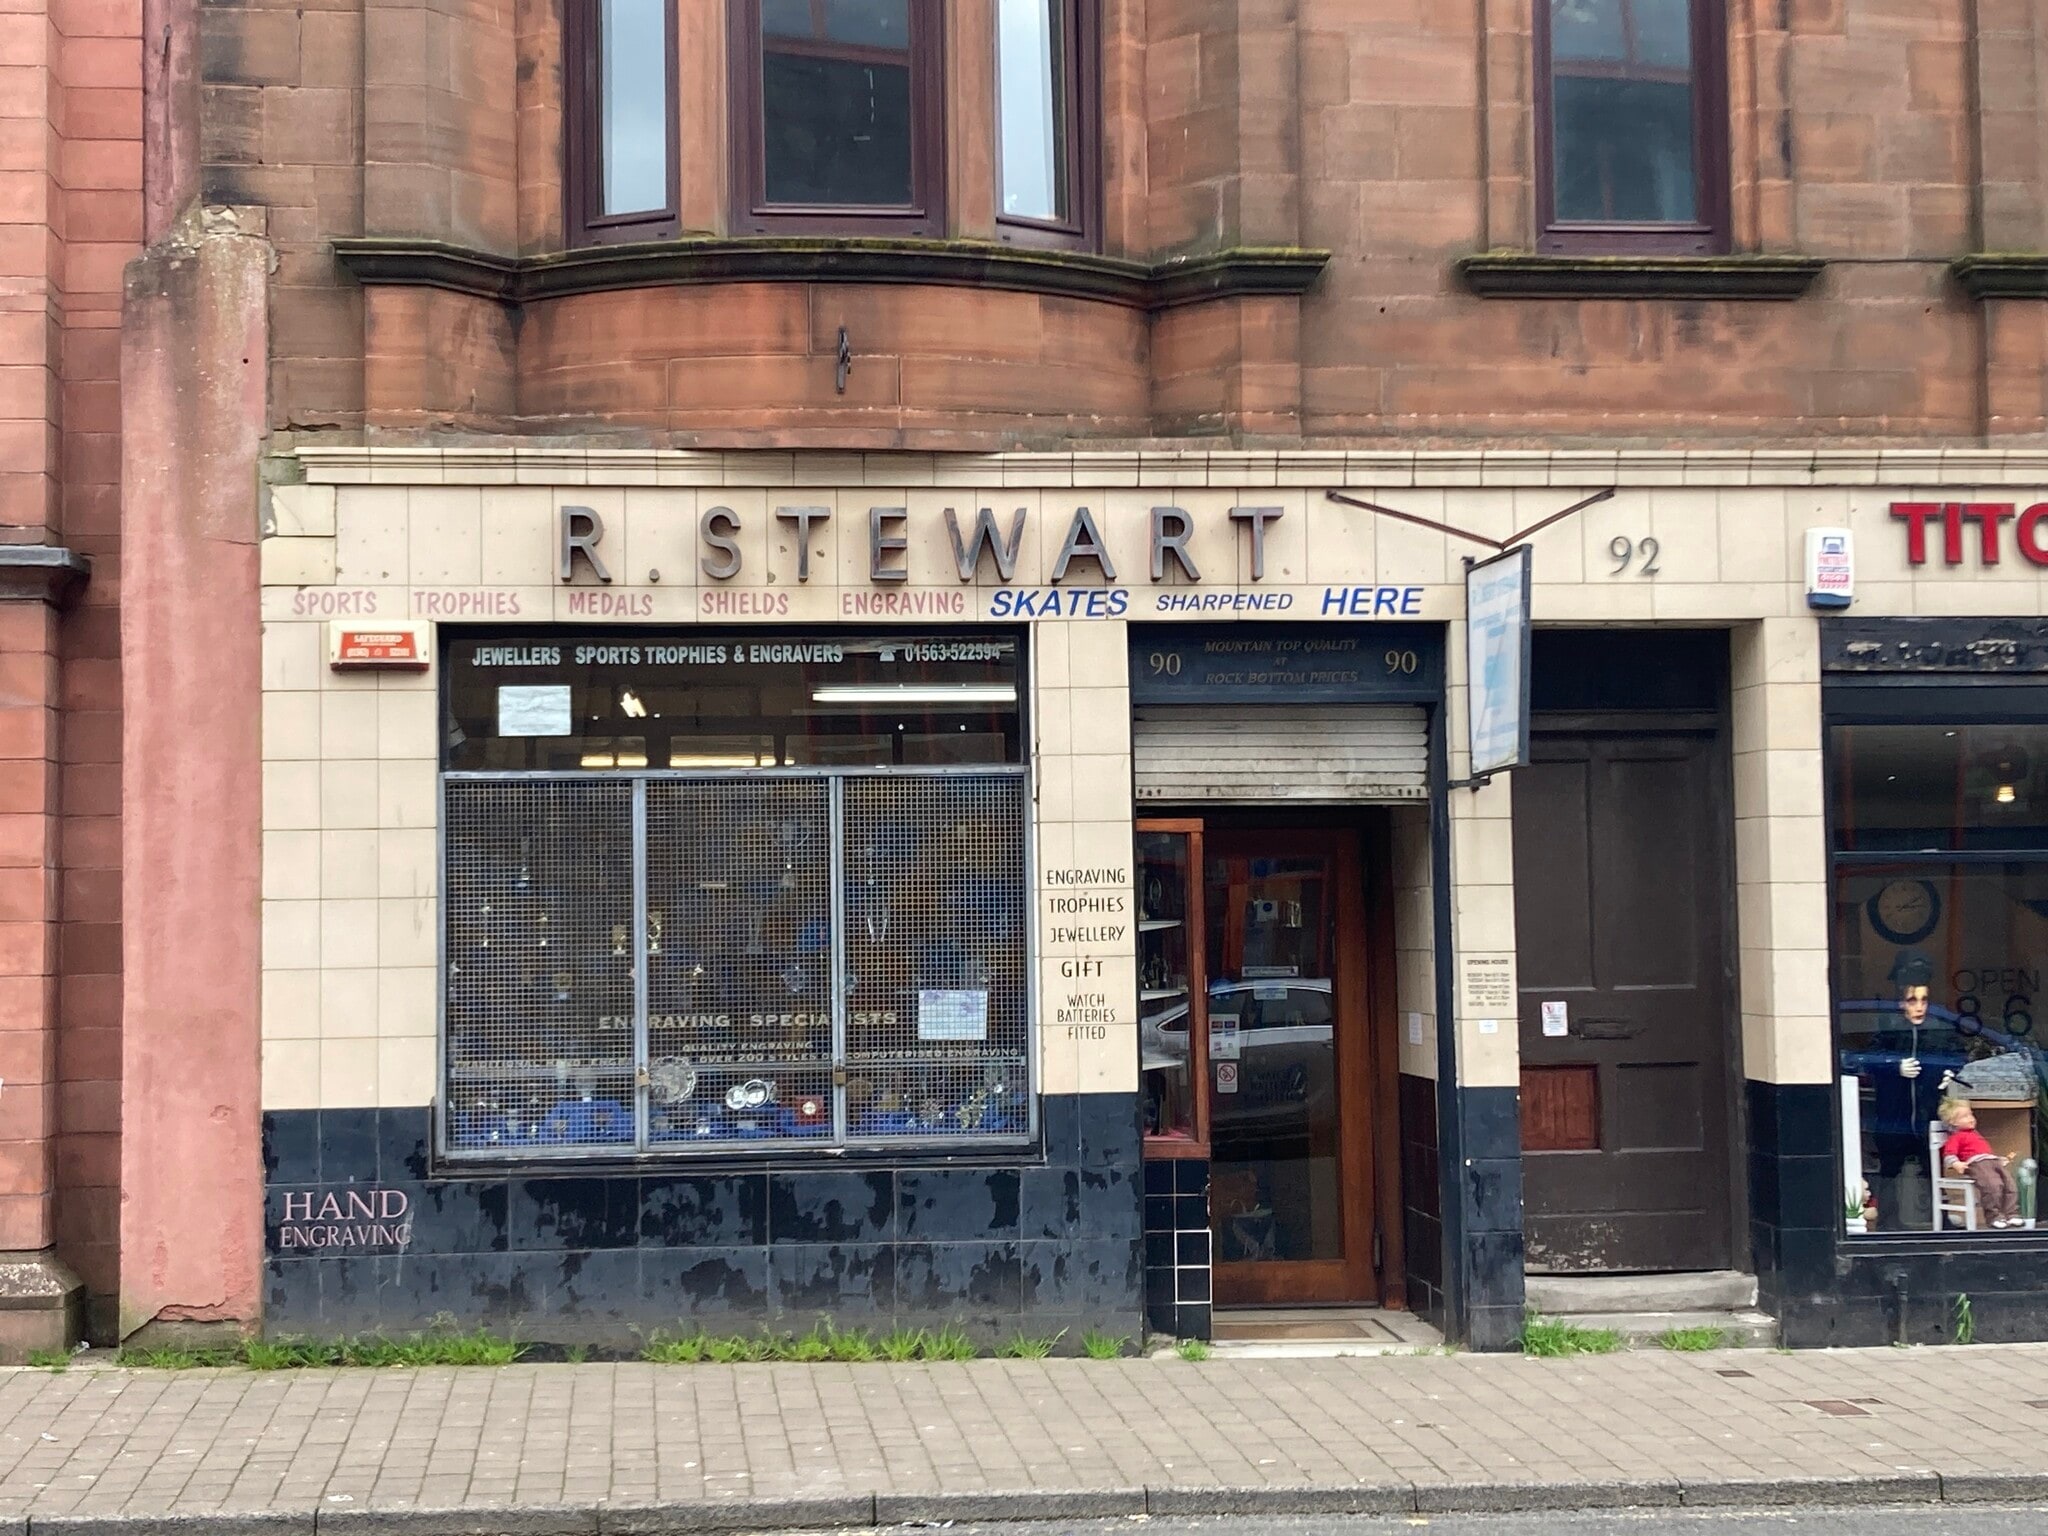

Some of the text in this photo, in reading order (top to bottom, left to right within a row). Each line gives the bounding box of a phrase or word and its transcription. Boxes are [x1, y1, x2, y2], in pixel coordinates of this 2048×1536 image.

[701, 505, 1284, 582] STEWART
[1609, 535, 1661, 576] 92
[292, 590, 965, 616] SPORTS TROPHIES MEDALS SHIELDS ENGRAVING
[990, 587, 1424, 617] SKATES SHARPENED HERE
[472, 643, 1001, 666] JEWELLERS SPORTS TROPHIES & ENGRAVERS 01563-522594
[1204, 639, 1359, 653] MOUNTAIN TOP QUALITY
[1150, 652, 1182, 676] 90
[1273, 657, 1288, 666] AT
[1384, 650, 1418, 675] 90
[1205, 671, 1358, 684] ROCK BOTTOM PRICES
[1046, 868, 1125, 885] ENGRAVING
[1049, 896, 1124, 913] TROPHIES
[1050, 925, 1126, 943] JEWELLERY
[1061, 961, 1103, 978] GIFT
[1952, 968, 2040, 993] OPEN
[1067, 993, 1105, 1007] WATCH
[598, 1012, 897, 1030] ENRAVING SPECIAISTS
[1057, 1008, 1116, 1022] BATTERIES
[1068, 1026, 1106, 1039] FITTED
[682, 1043, 736, 1052] QUALITY
[699, 1054, 734, 1064] OVER
[737, 1053, 764, 1063] 200
[282, 1190, 408, 1221] HAND
[280, 1223, 412, 1248] ENGRAVING
